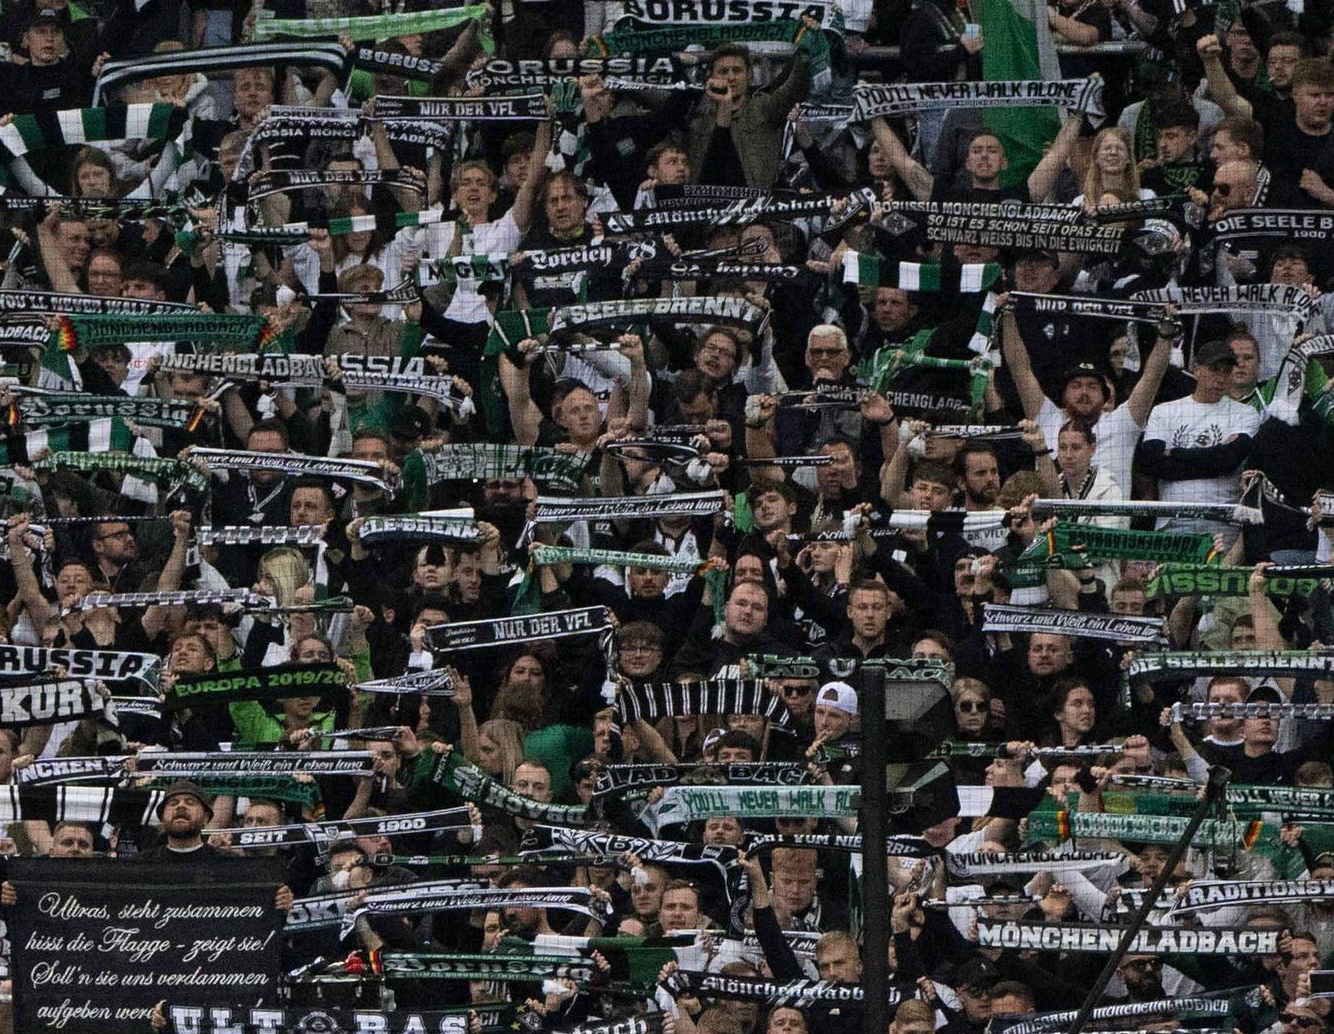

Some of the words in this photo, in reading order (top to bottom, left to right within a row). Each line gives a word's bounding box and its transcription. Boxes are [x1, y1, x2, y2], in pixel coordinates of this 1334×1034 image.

[916, 84, 968, 100] NEVER
[976, 82, 1022, 98] WALK
[1026, 82, 1076, 99] ALONE
[419, 102, 450, 116] NUR
[456, 102, 485, 116] DER
[488, 102, 517, 116] VFL
[1215, 217, 1248, 232] DIE
[1253, 215, 1313, 229] SEELE
[1238, 286, 1276, 300] WALK
[494, 622, 526, 641] NUR
[530, 618, 560, 636] DER
[564, 613, 593, 631] VFL
[176, 678, 261, 695] EUROPA
[739, 789, 781, 810] NEVER
[790, 789, 827, 809] WALK
[239, 830, 286, 845] SEIT
[378, 818, 426, 832] 1900
[38, 892, 110, 923] Ultras,
[118, 902, 158, 919] steht
[162, 902, 263, 930] zusammen
[25, 935, 62, 951] hisst
[67, 933, 95, 951] die
[101, 930, 170, 964] Flagge
[185, 935, 234, 963] zeigt
[95, 970, 118, 986] sie
[122, 974, 154, 986] uns
[157, 968, 269, 986] verdammen
[37, 1000, 114, 1027] aufgeben
